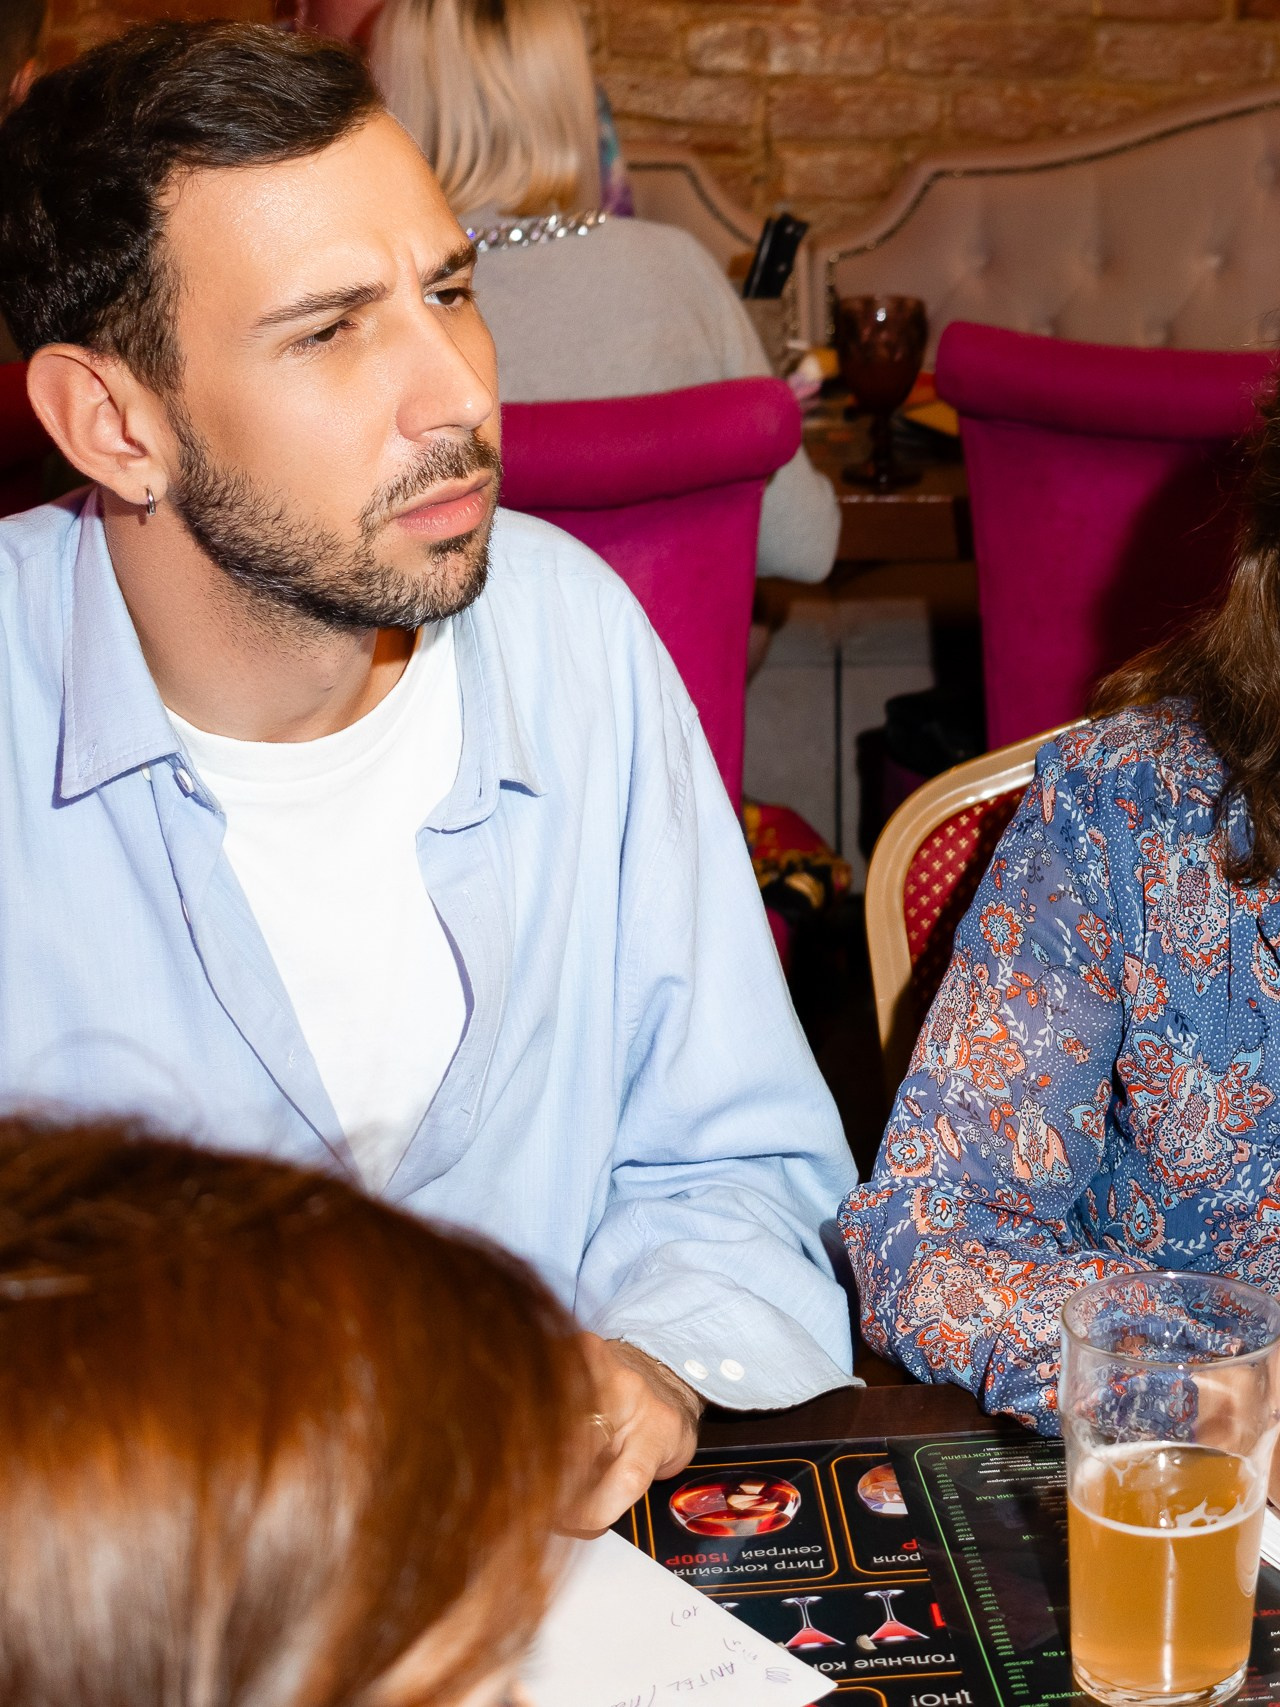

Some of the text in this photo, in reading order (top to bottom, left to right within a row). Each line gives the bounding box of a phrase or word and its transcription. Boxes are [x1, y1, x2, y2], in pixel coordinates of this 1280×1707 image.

[940, 1451, 992, 1461] КОКТЕЙЛИ
[664, 1544, 823, 1566] сенграй 1500Р
[872, 1551, 922, 1566] роля
[672, 1558, 825, 1577] Литр коктейля
[854, 1653, 955, 1669] гольные
